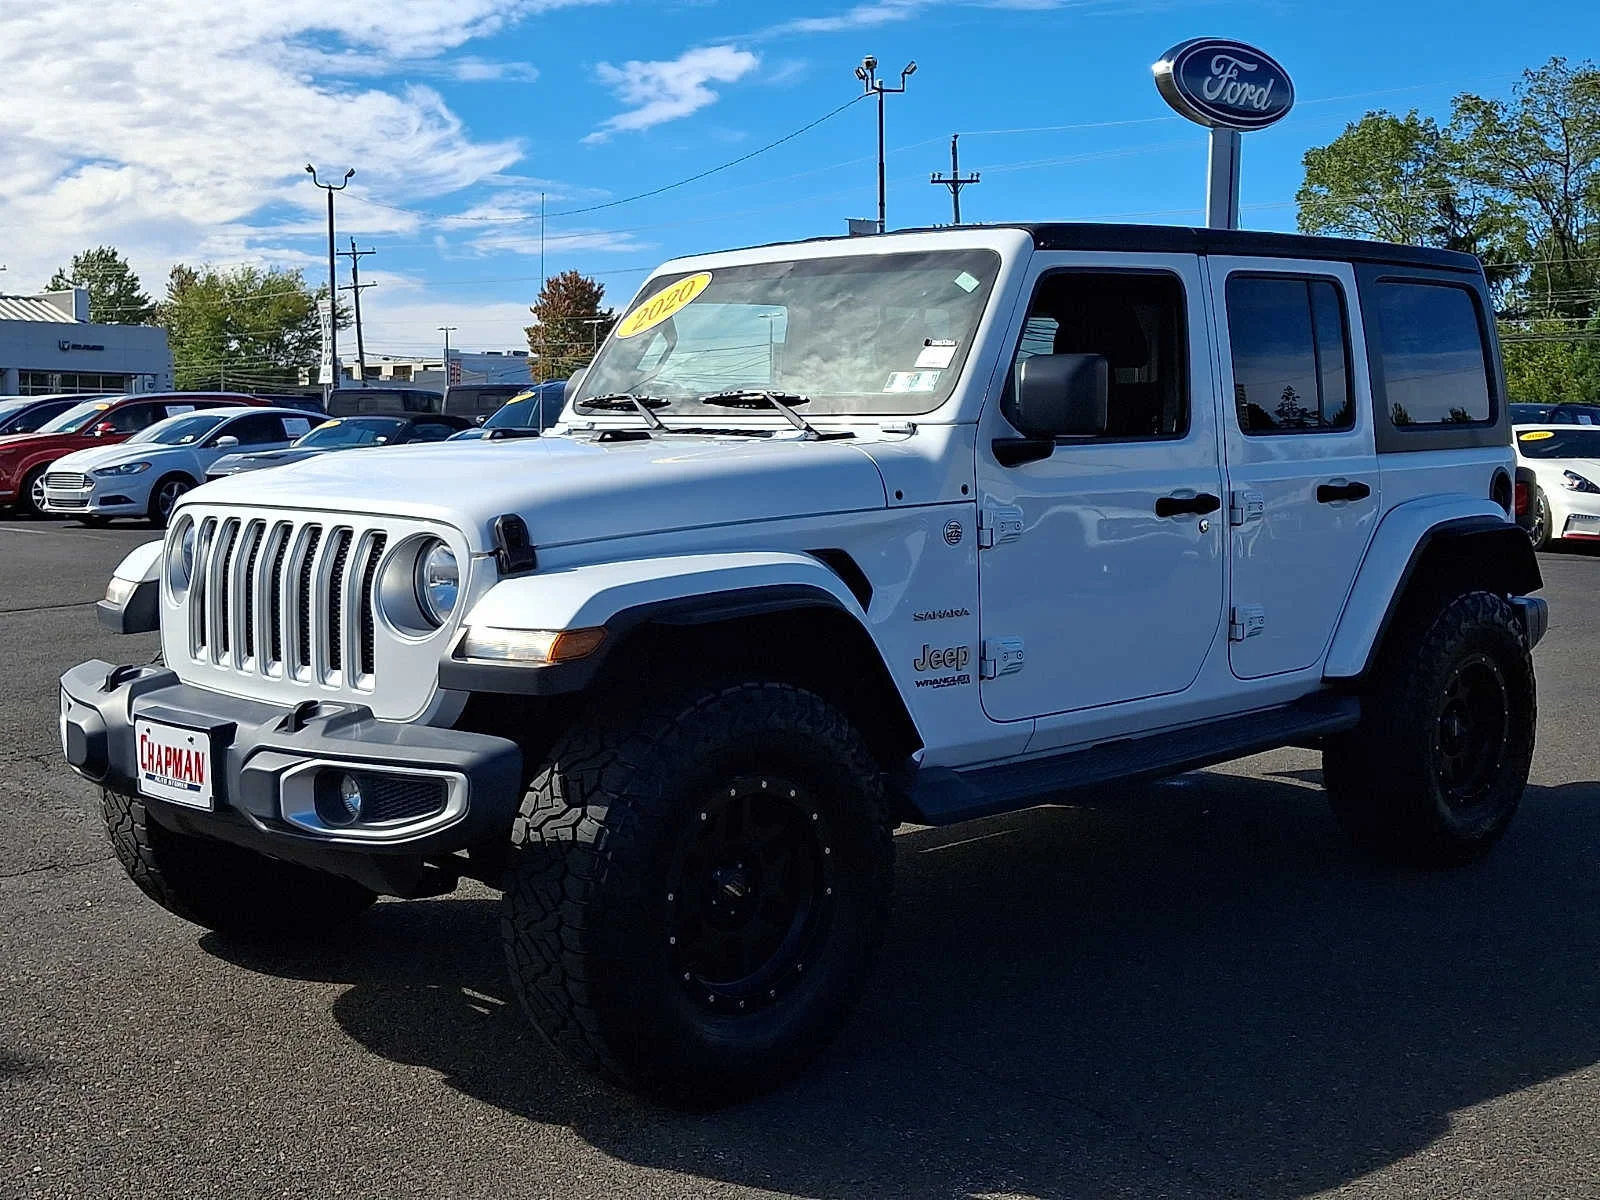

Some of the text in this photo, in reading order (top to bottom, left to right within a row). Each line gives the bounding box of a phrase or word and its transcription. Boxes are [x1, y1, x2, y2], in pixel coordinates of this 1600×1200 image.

[1202, 54, 1275, 111] Ford
[632, 280, 696, 332] 2020
[913, 607, 971, 621] SAHARA
[913, 643, 970, 672] Jeep
[914, 674, 970, 687] WRANGLER
